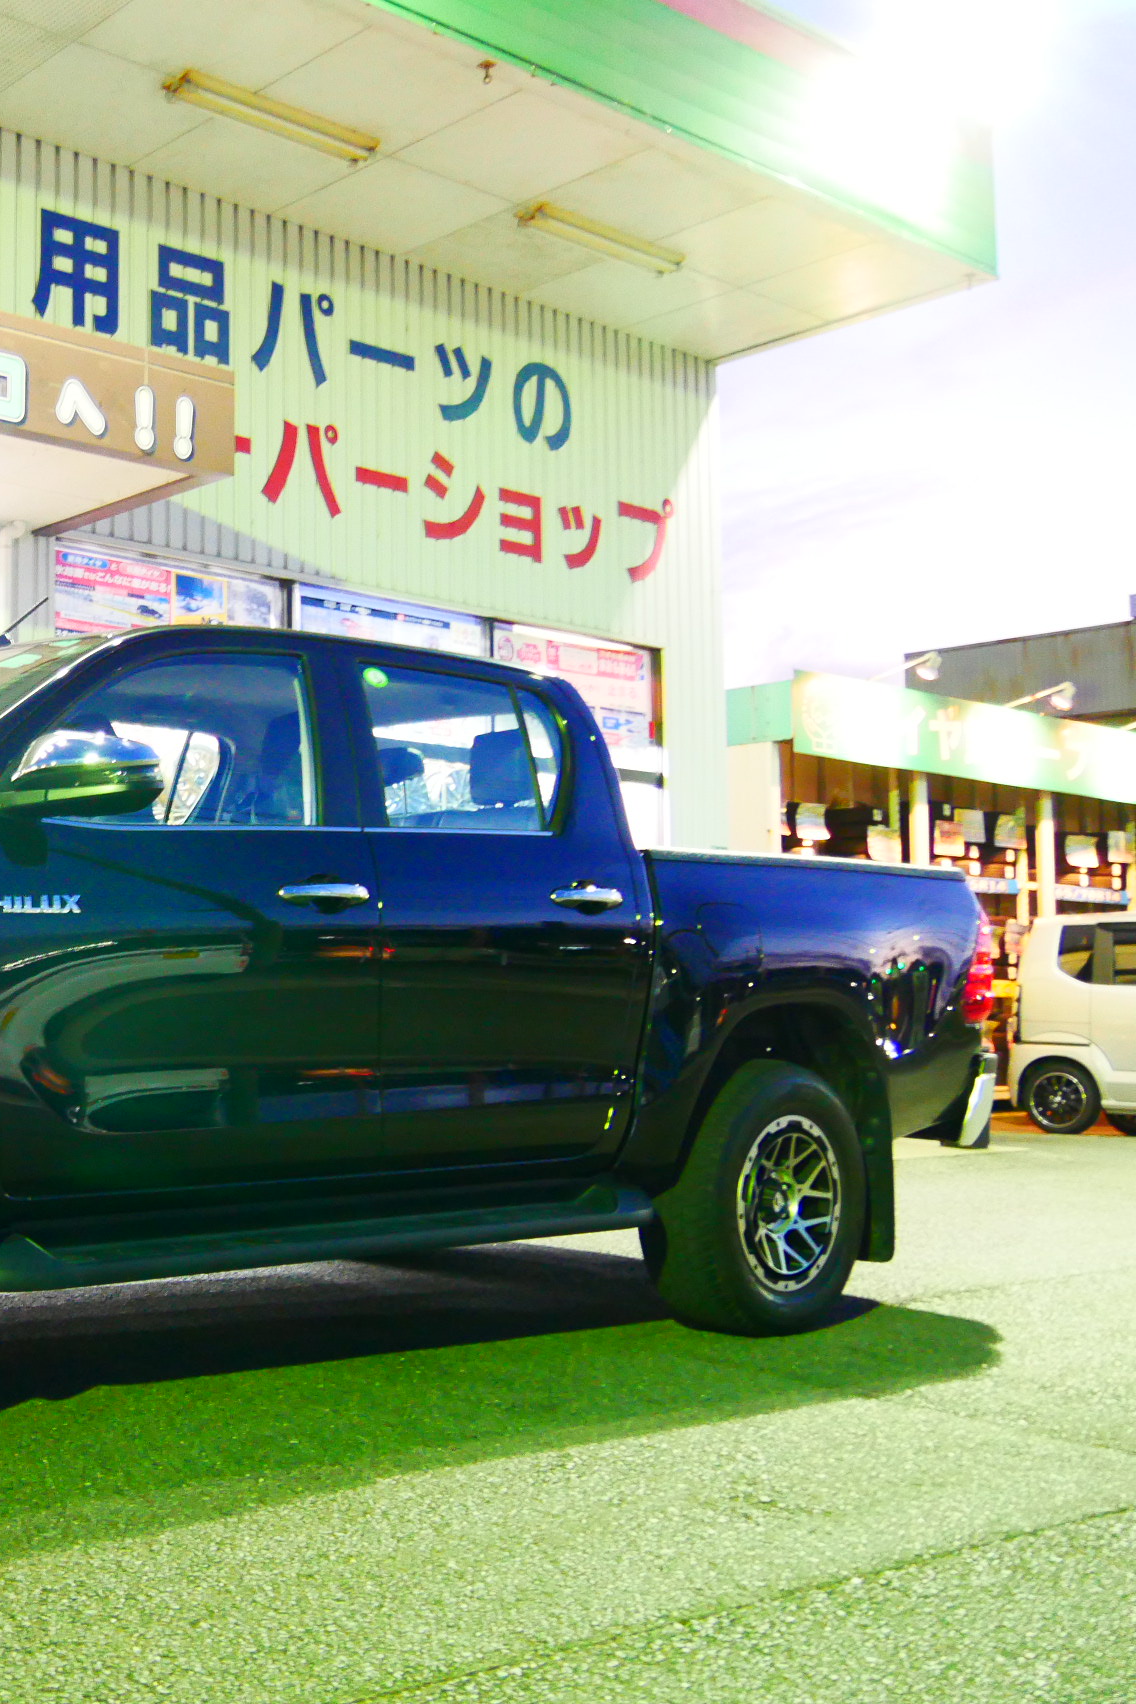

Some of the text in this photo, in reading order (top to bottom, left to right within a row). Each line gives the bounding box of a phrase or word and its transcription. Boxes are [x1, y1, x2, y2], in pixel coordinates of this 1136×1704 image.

[31, 207, 572, 451] 用品パーツの
